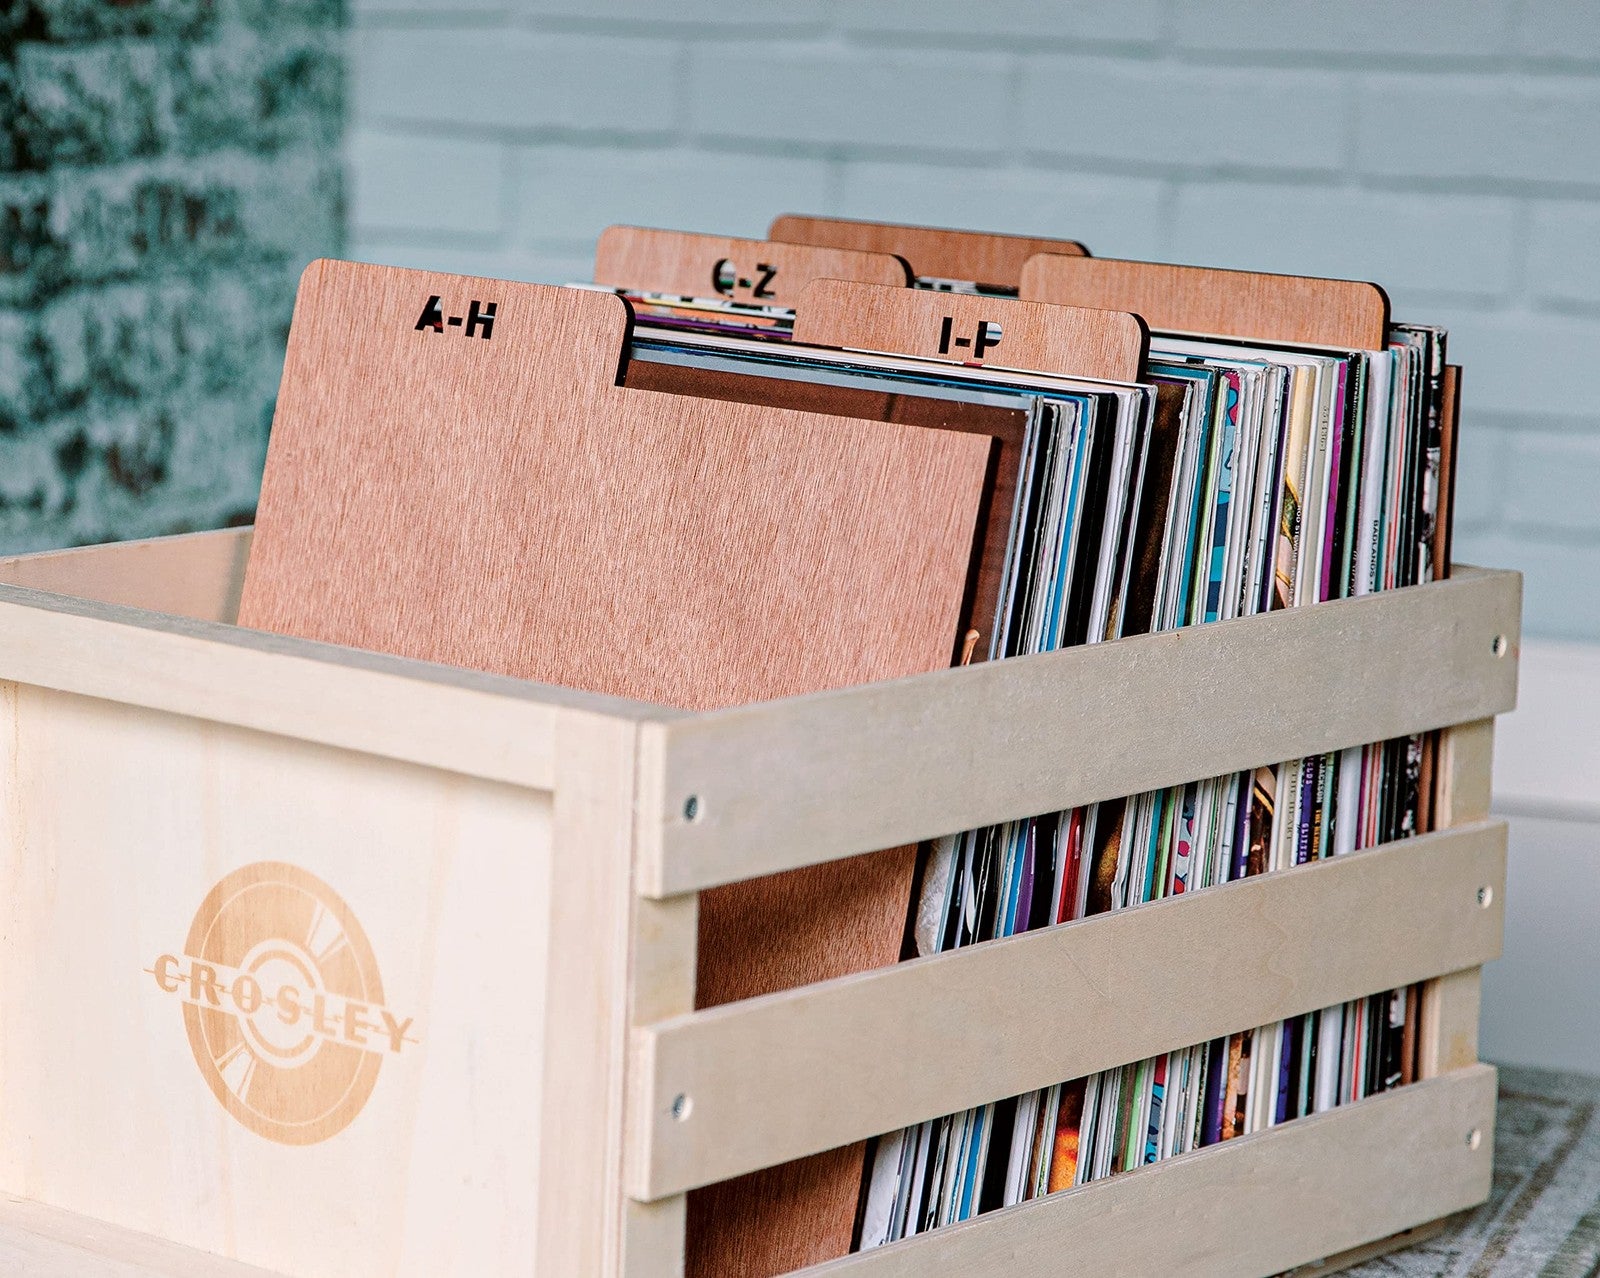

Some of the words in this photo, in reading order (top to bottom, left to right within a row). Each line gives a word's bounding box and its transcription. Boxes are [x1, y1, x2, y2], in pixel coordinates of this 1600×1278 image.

[414, 295, 498, 340] A-H
[938, 316, 1003, 359] I-P
[1292, 525, 1301, 562] STEWART
[1370, 520, 1379, 577] BADLANDS
[1316, 764, 1327, 804] JACKSON
[1286, 801, 1296, 841] HEART
[154, 954, 414, 1053] CROSLEY
